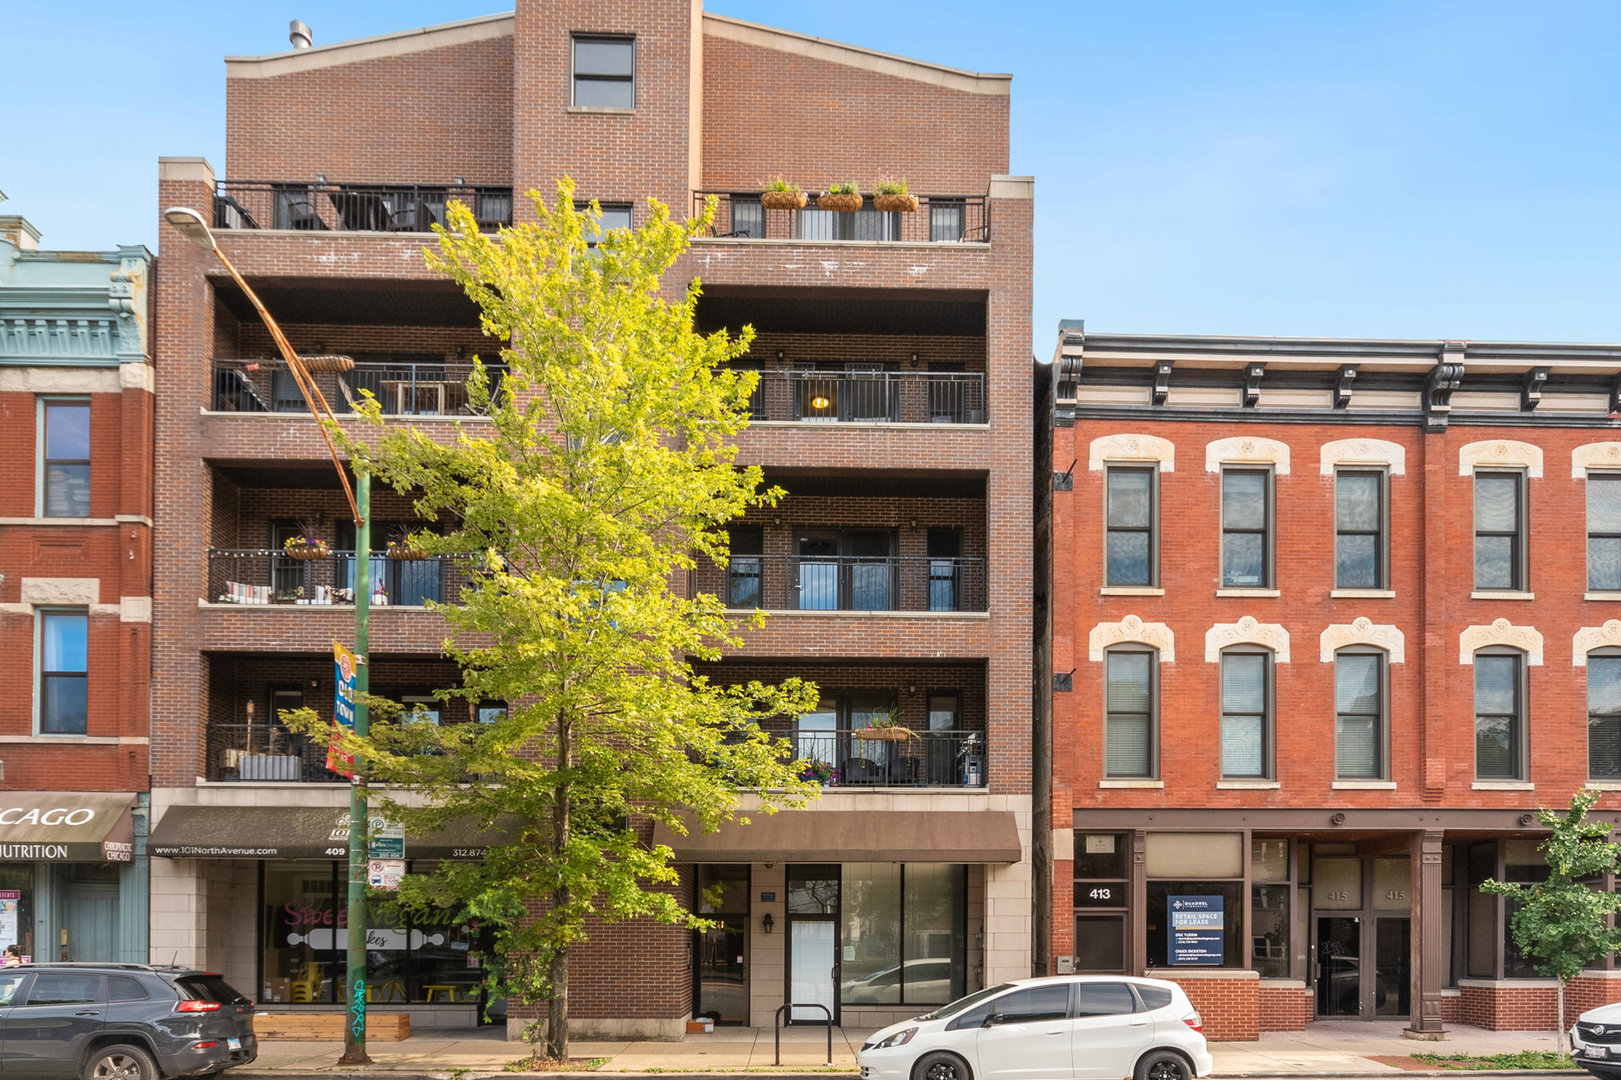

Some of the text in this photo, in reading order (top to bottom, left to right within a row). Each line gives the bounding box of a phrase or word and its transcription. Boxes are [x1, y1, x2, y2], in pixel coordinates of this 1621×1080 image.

[336, 700, 354, 723] TOWN
[0, 808, 95, 825] CAGO
[0, 844, 68, 858] UTRITION
[107, 851, 131, 861] CHICAGO
[155, 846, 277, 856] www.101NorthAvenue.com
[1089, 888, 1111, 899] 413
[1329, 890, 1348, 900] 415
[1386, 890, 1406, 900] 415
[284, 901, 451, 935] Swee Vegan
[366, 930, 388, 947] kes
